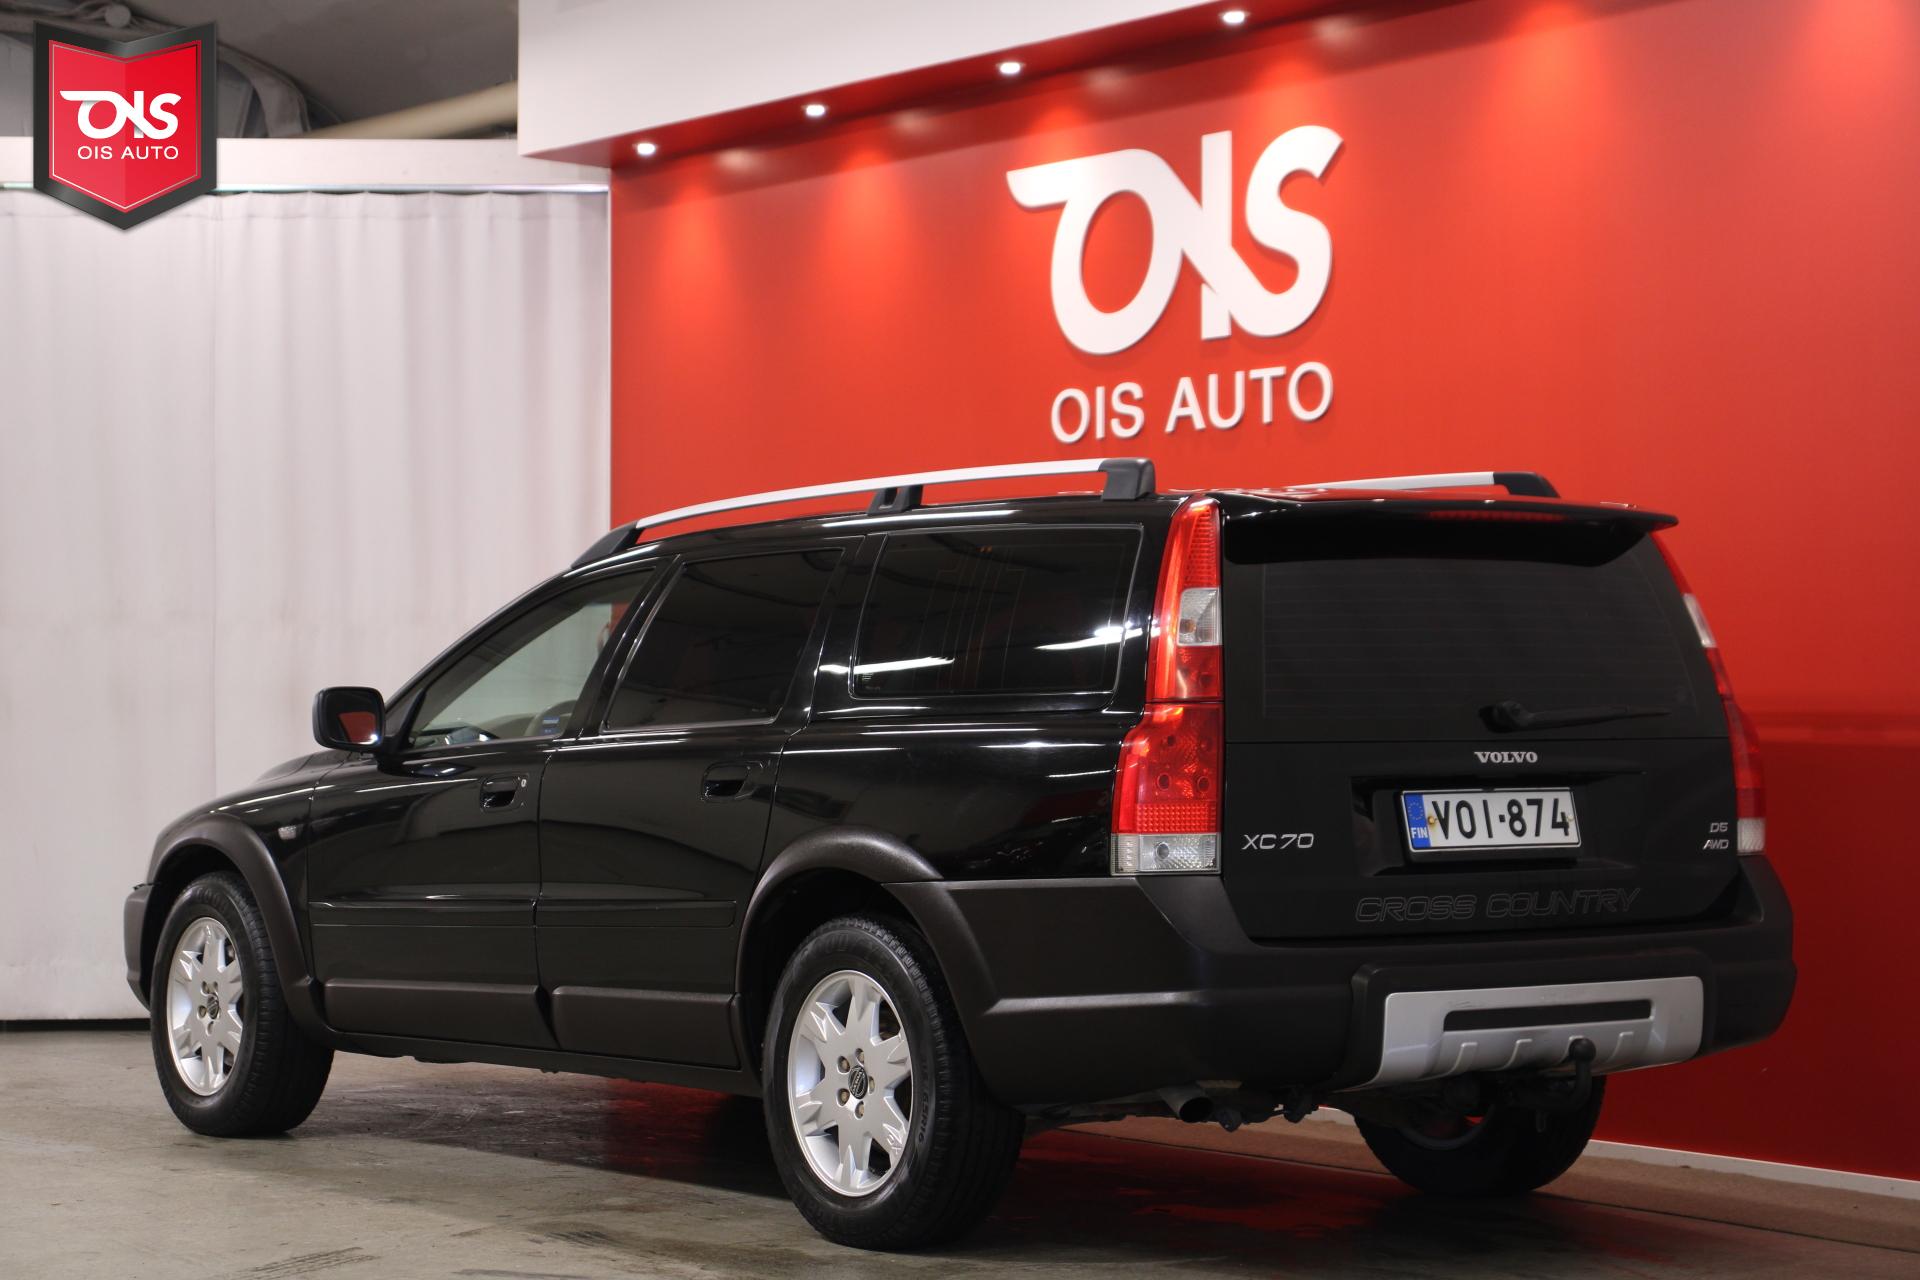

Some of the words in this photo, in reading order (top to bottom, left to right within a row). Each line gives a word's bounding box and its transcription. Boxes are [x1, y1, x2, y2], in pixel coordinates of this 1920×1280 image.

[1006, 125, 1343, 355] OIS
[1051, 382, 1145, 443] OIS
[1165, 362, 1333, 434] AUTO
[1474, 751, 1538, 763] VOLVO
[1432, 798, 1569, 840] VOI-874
[1709, 822, 1728, 833] D5
[1411, 827, 1428, 839] FIN
[1703, 839, 1729, 850] AWD
[1355, 894, 1477, 922] CROSS
[1486, 888, 1641, 918] COUNTRY
